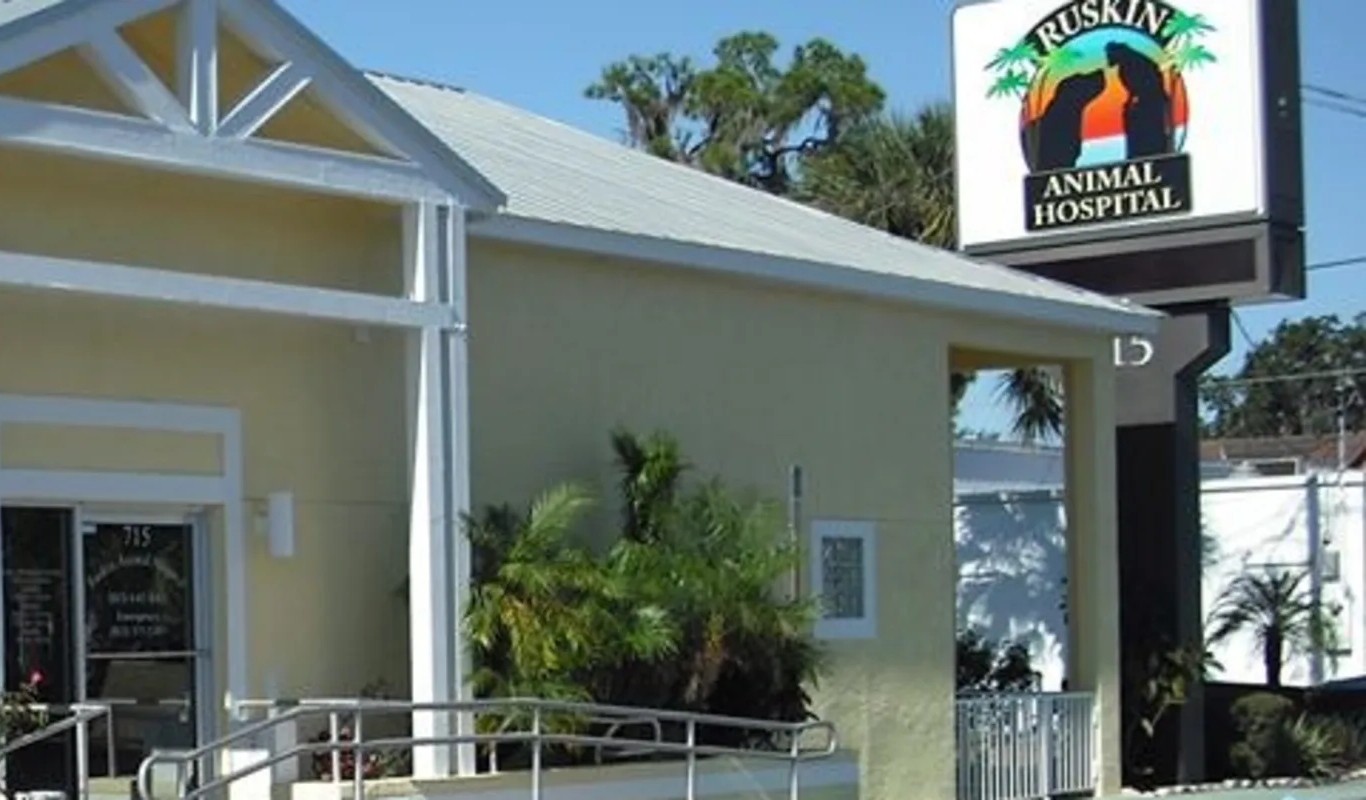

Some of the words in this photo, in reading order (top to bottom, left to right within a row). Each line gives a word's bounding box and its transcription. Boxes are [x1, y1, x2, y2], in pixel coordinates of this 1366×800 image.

[1036, 0, 1168, 52] RUSKIN
[1043, 161, 1162, 198] ANIMAL
[1034, 187, 1182, 227] HOSPITAL
[122, 525, 152, 548] 715
